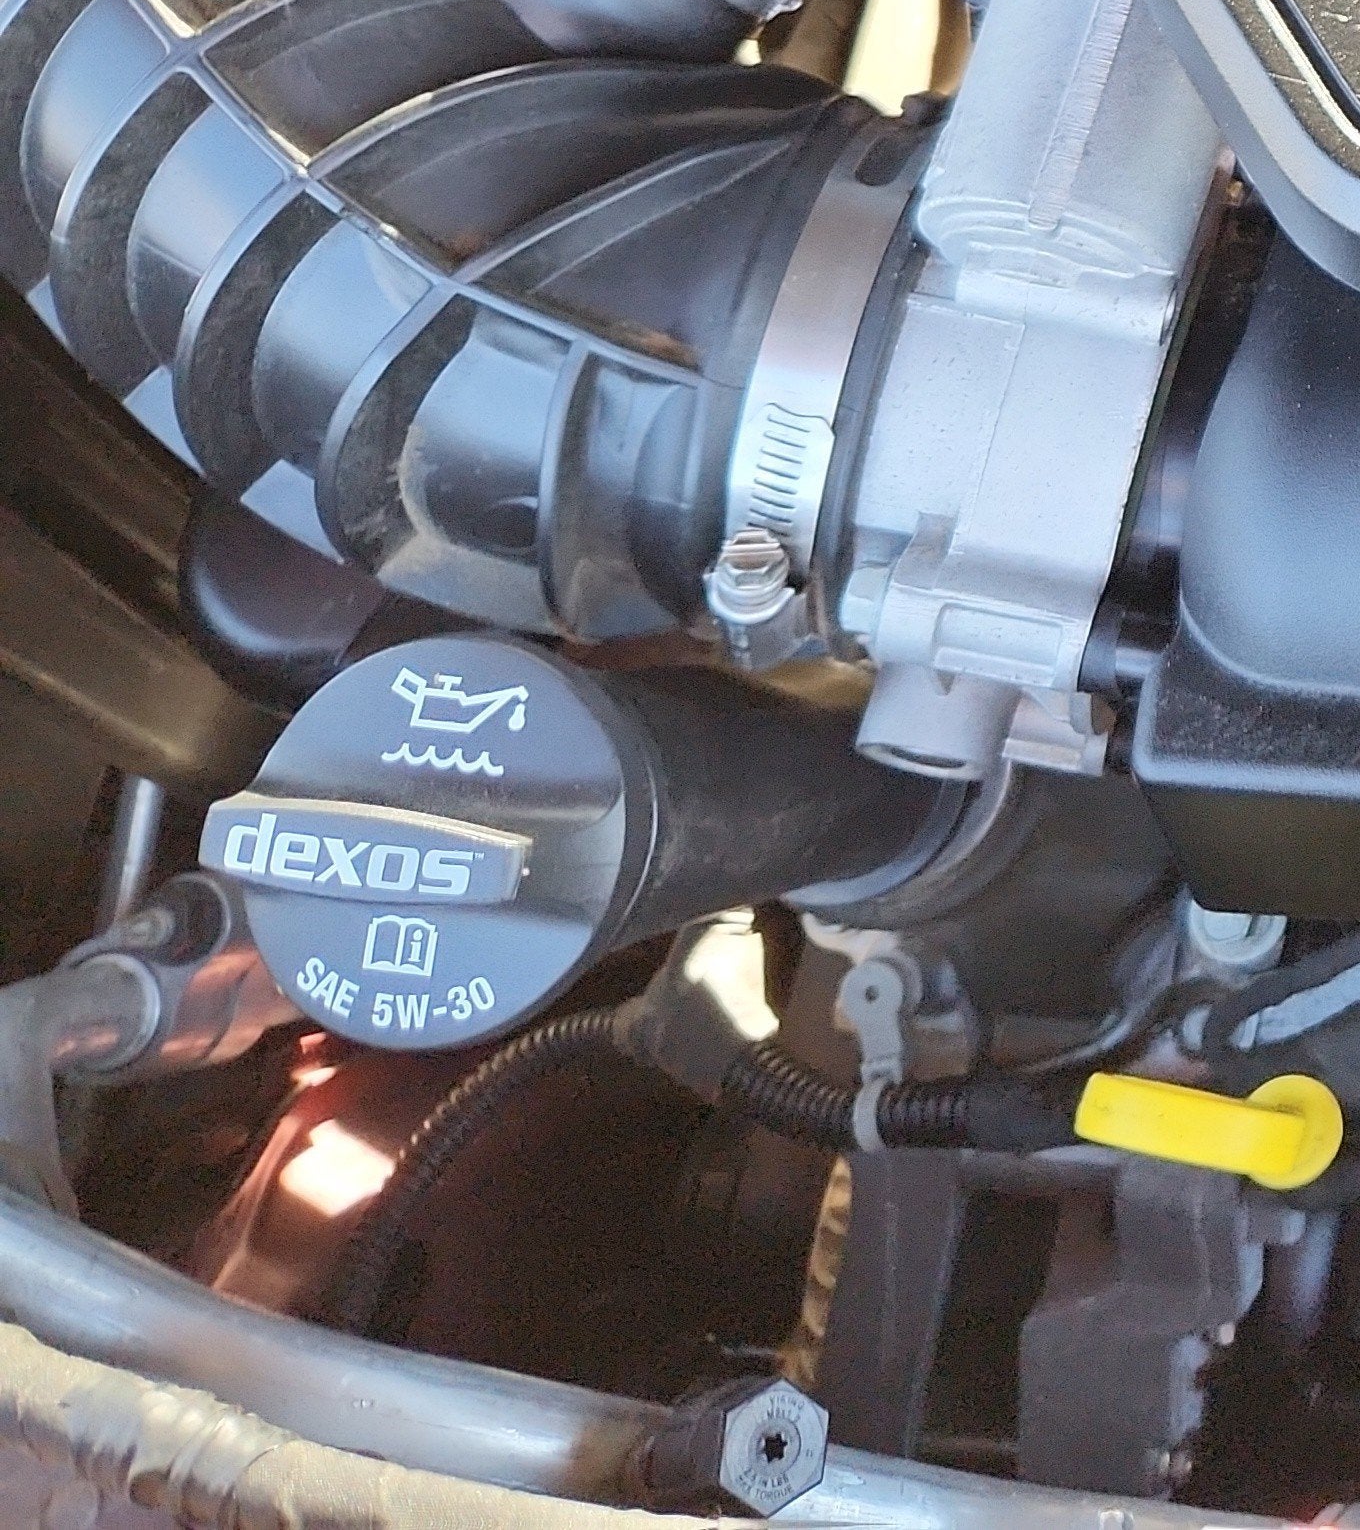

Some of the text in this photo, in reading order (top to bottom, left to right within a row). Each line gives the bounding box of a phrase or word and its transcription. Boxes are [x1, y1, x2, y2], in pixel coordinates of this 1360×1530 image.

[297, 957, 495, 1029] SAE 5W-30
[754, 1485, 795, 1501] TORQUE
